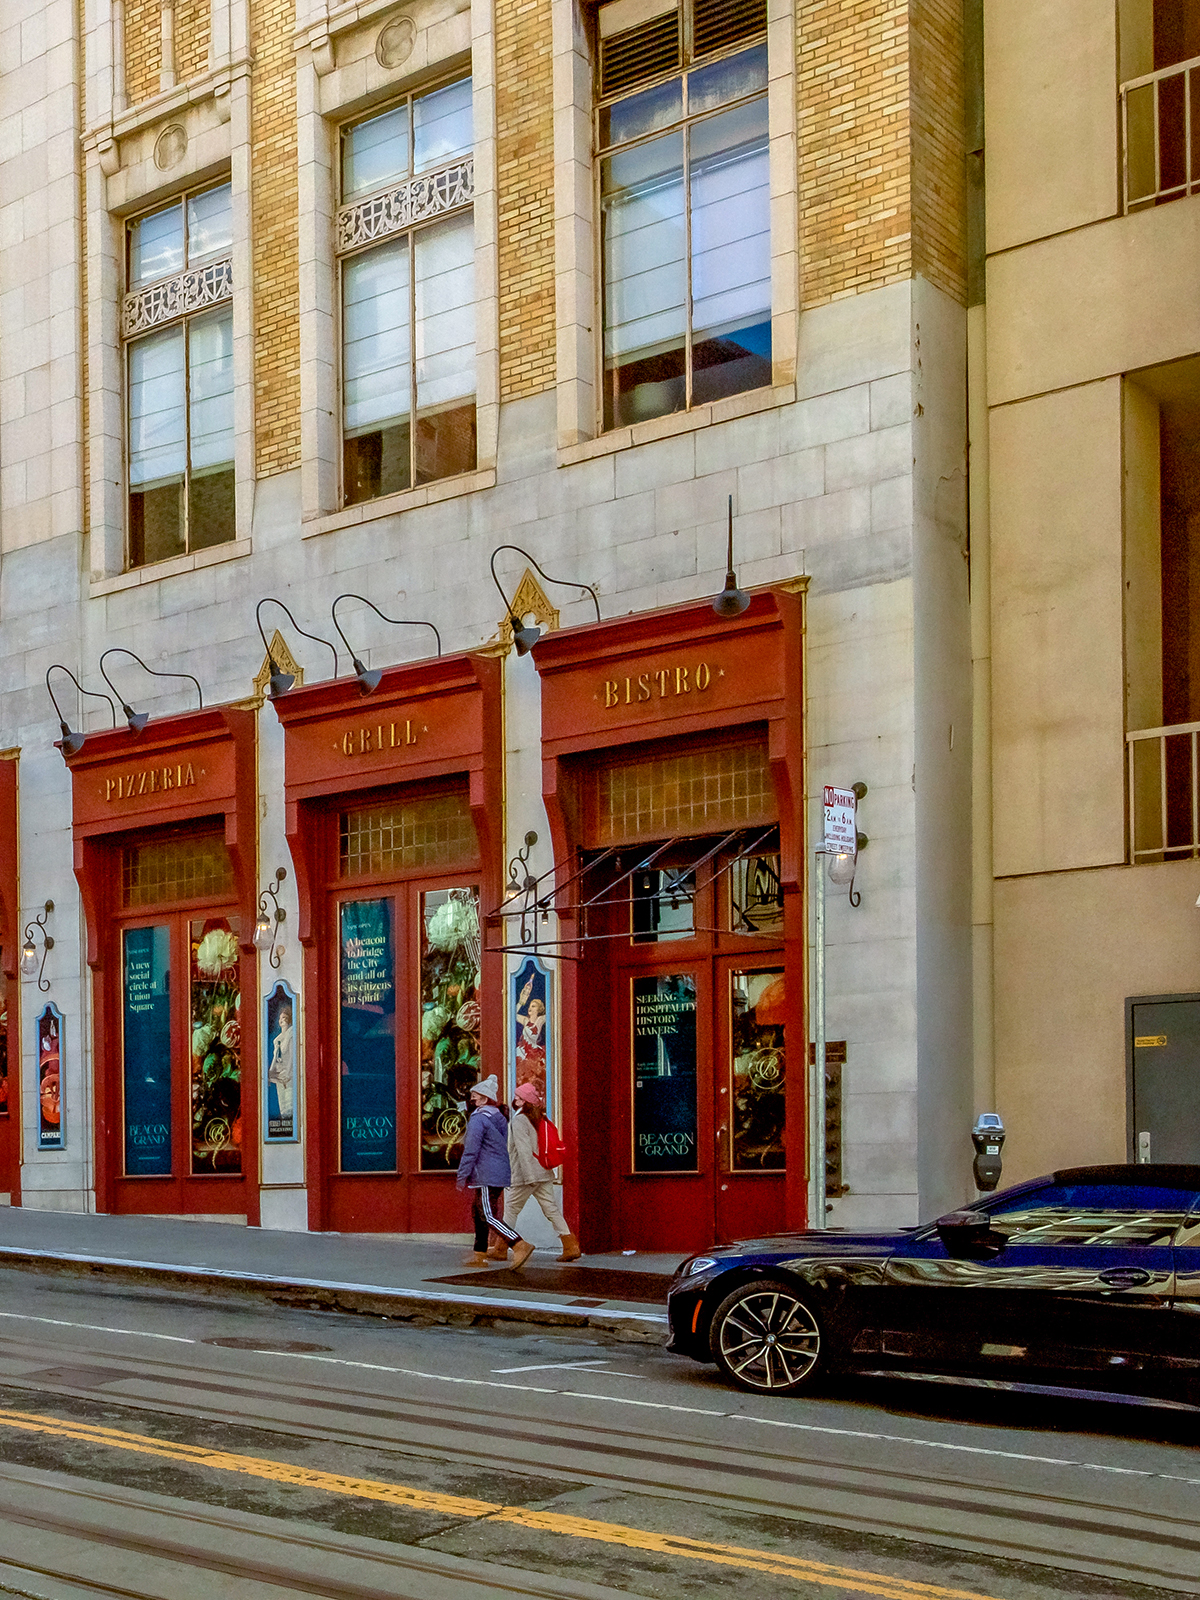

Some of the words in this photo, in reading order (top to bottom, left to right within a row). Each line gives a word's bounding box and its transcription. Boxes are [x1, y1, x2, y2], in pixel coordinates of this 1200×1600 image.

[605, 663, 710, 709] BISTRO
[343, 720, 417, 755] GRILL
[106, 763, 195, 801] PIZZERIA
[824, 787, 834, 806] NO
[834, 793, 854, 808] PARKING
[841, 812, 846, 824] 6
[355, 936, 386, 946] beacon
[347, 950, 355, 958] to
[357, 947, 384, 958] bridge
[347, 961, 360, 969] the
[362, 959, 378, 968] City
[129, 971, 150, 979] social
[347, 970, 363, 980] and
[365, 969, 376, 980] all
[377, 968, 386, 978] of
[129, 981, 148, 991] circle
[150, 981, 156, 989] at
[347, 983, 358, 992] its
[359, 981, 392, 991] citizens
[129, 992, 150, 1001] Union
[347, 995, 356, 1004] in
[357, 992, 380, 1005] spirit
[636, 993, 677, 1004] SEEKING
[129, 1003, 155, 1013] Square
[636, 1002, 697, 1014] HOSPITALITY
[636, 1014, 676, 1026] HISTORY
[636, 1025, 679, 1036] MAKERS.
[346, 1116, 393, 1129] BEACON
[129, 1124, 169, 1136] BEACON
[351, 1128, 389, 1138] GRAND
[134, 1134, 165, 1145] GRAND
[639, 1132, 694, 1146] BEACON
[644, 1144, 689, 1156] GRAND
